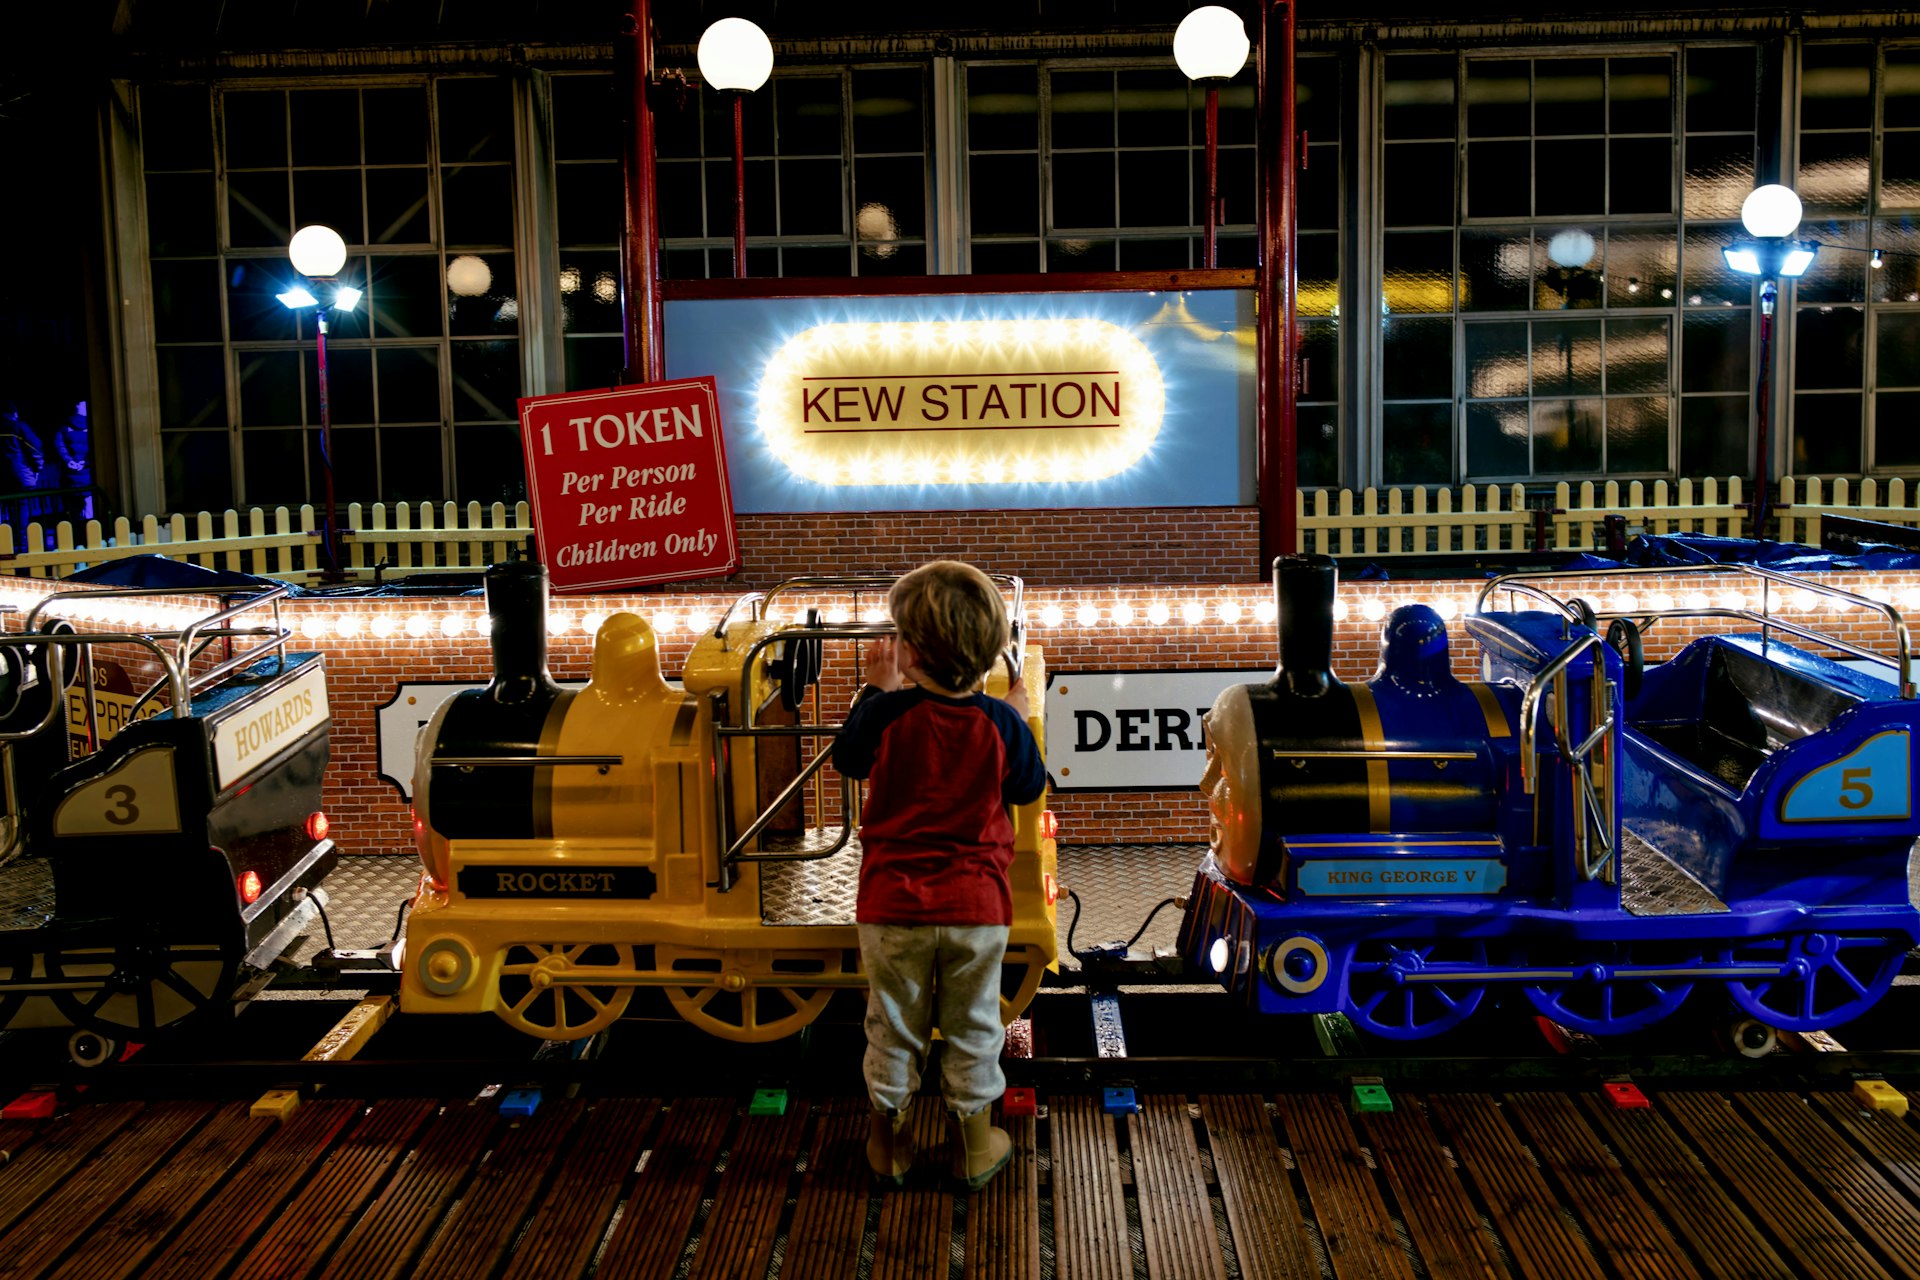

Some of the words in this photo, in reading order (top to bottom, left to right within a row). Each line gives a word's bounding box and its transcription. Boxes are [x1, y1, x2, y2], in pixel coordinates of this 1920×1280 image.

[802, 386, 905, 423] KEW
[921, 381, 1120, 422] STATION
[541, 422, 554, 455] 1
[568, 404, 703, 452] TOKEN
[560, 471, 604, 495] Per
[610, 462, 696, 490] Person
[578, 502, 622, 526] Per
[628, 491, 687, 521] Ride
[556, 538, 658, 568] Children
[664, 528, 718, 557] Only
[69, 694, 160, 732] EXPRE
[234, 688, 313, 762] HOWARDS
[104, 784, 140, 826] 3
[1838, 767, 1874, 810] 5
[496, 872, 616, 892] ROCKET
[1328, 871, 1373, 884] KING
[1379, 870, 1458, 883] GEORGE
[1464, 870, 1477, 883] V
